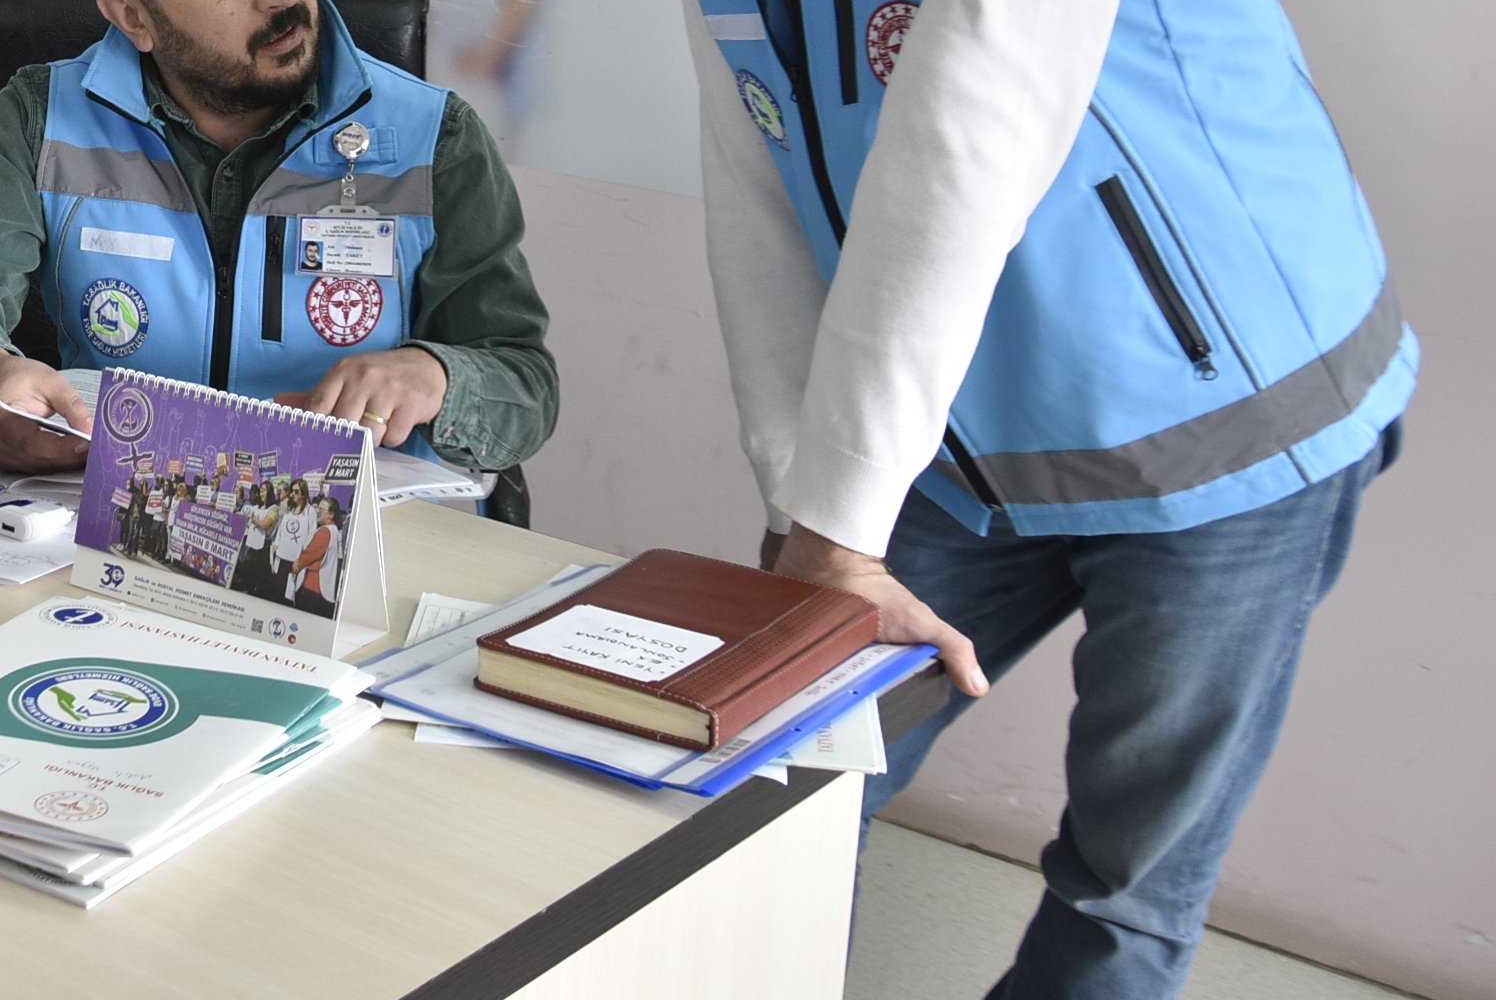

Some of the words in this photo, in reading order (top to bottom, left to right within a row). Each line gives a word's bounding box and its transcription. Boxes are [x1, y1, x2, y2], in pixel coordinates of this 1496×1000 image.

[332, 457, 360, 468] YAŞASIN
[328, 469, 334, 477] 8
[335, 468, 355, 477] MART
[204, 541, 209, 550] 8
[210, 545, 234, 561] MART
[120, 620, 200, 643] HASTANESİ
[604, 626, 688, 653] DOSYASI
[204, 639, 260, 657] DEVLET
[563, 645, 610, 659] KAYIT
[262, 654, 318, 673] TATVAN
[614, 658, 654, 673] YENİ
